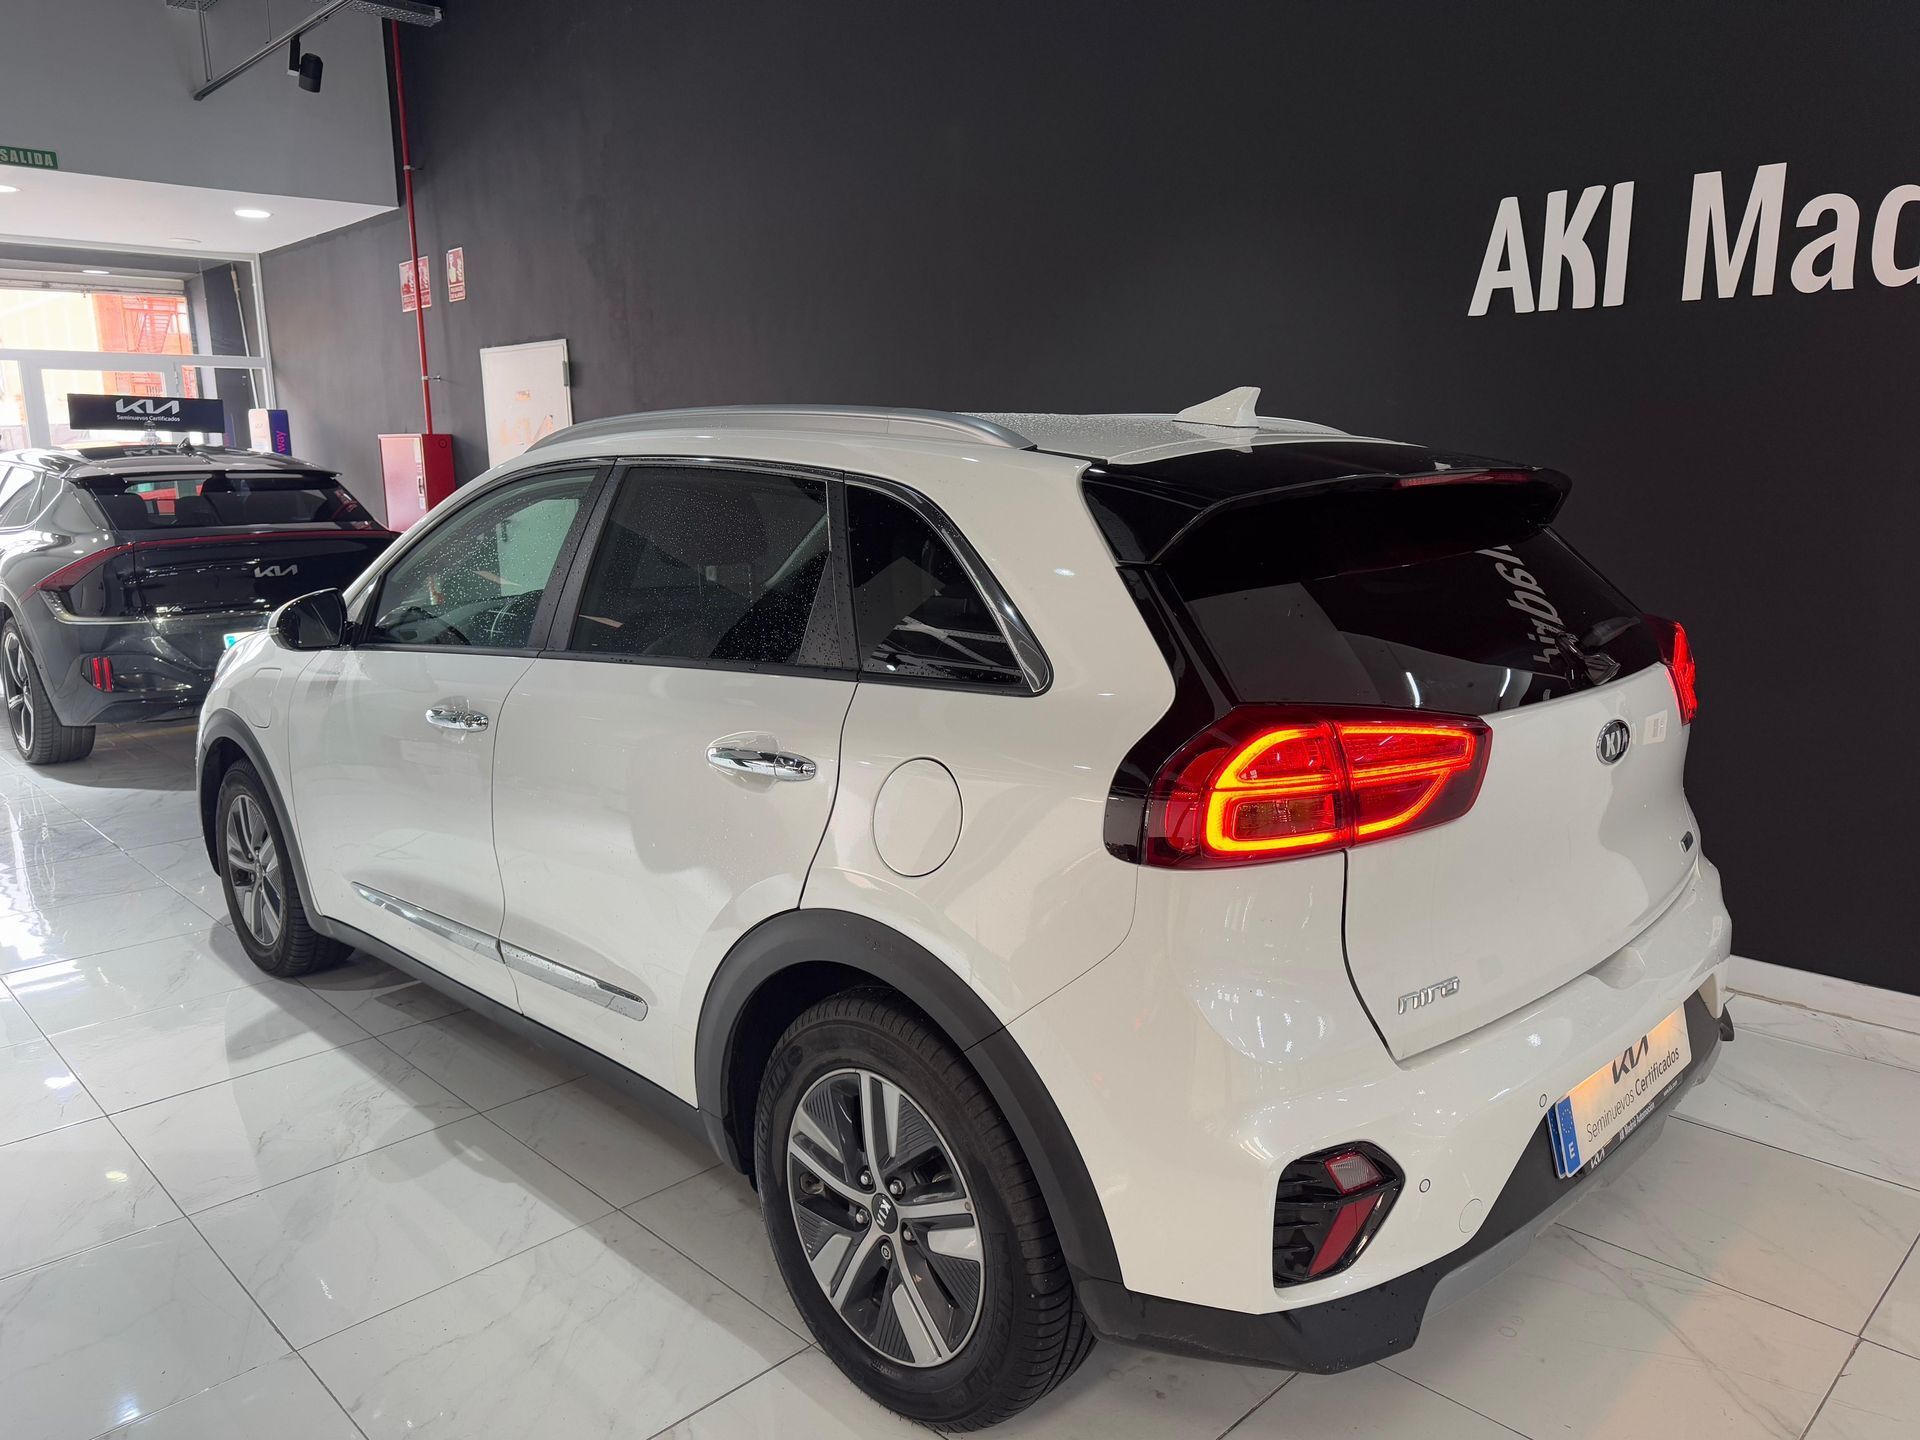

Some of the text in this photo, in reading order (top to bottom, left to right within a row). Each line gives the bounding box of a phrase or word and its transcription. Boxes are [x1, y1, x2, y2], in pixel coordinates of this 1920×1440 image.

[0, 148, 54, 167] SALIDA
[1468, 181, 1635, 317] AKI
[115, 398, 180, 415] KIA
[116, 414, 149, 422] Seminuevos
[254, 564, 299, 578] KIA
[1611, 1034, 1649, 1085] KIA
[1586, 1047, 1680, 1143] Seminuevos Certificados
[1568, 1141, 1576, 1160] E
[876, 1199, 891, 1227] KIA
